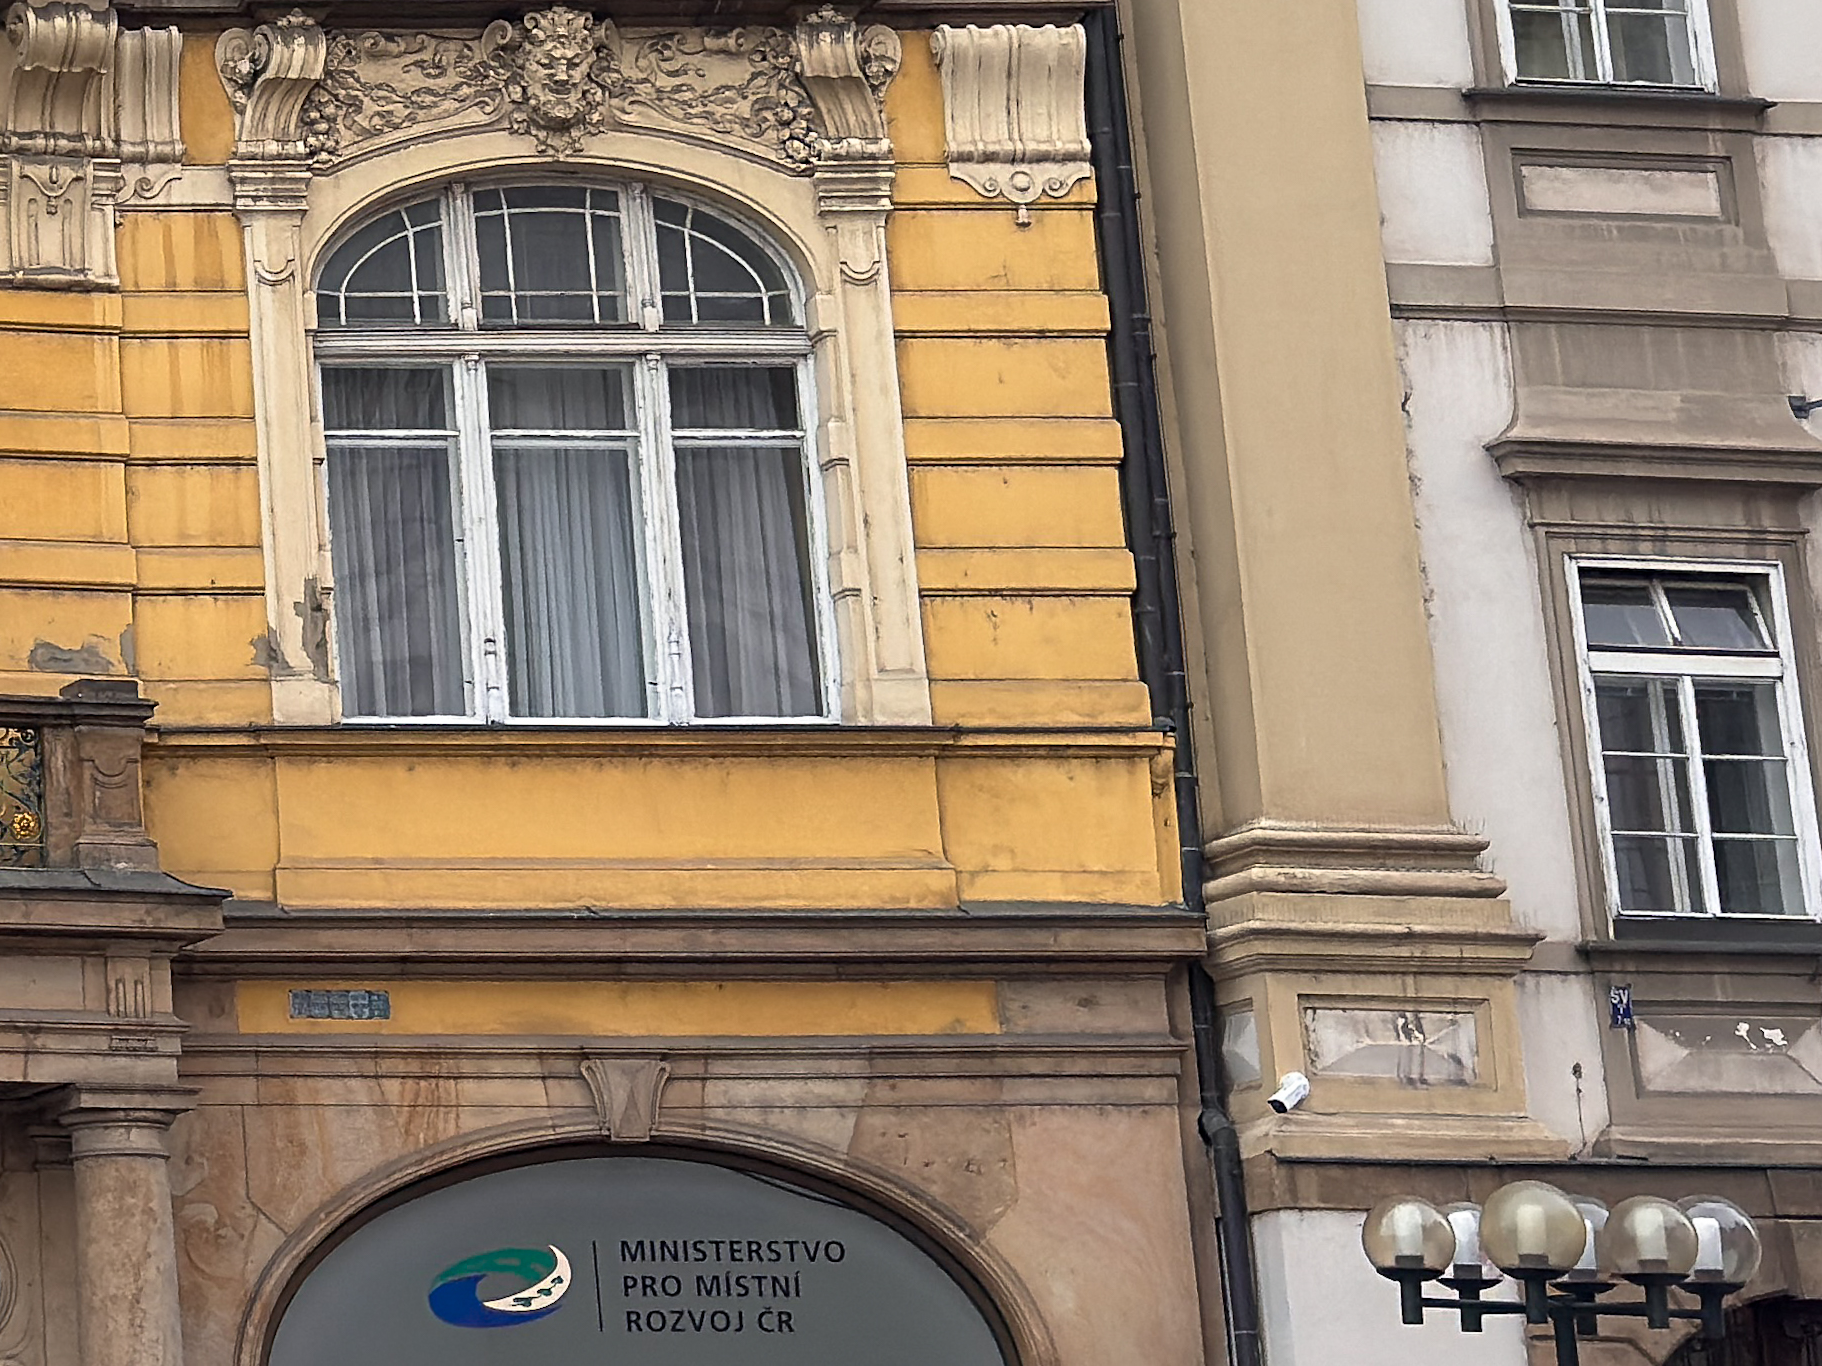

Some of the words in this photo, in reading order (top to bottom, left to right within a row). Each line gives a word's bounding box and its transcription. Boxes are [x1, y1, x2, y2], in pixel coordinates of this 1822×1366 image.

[620, 1240, 846, 1263] MINISTERSTVO
[623, 1274, 682, 1297] PRO
[695, 1270, 802, 1297] MÍSTNÍ
[626, 1310, 744, 1333] ROZVOJ
[757, 1307, 795, 1333] ČR
